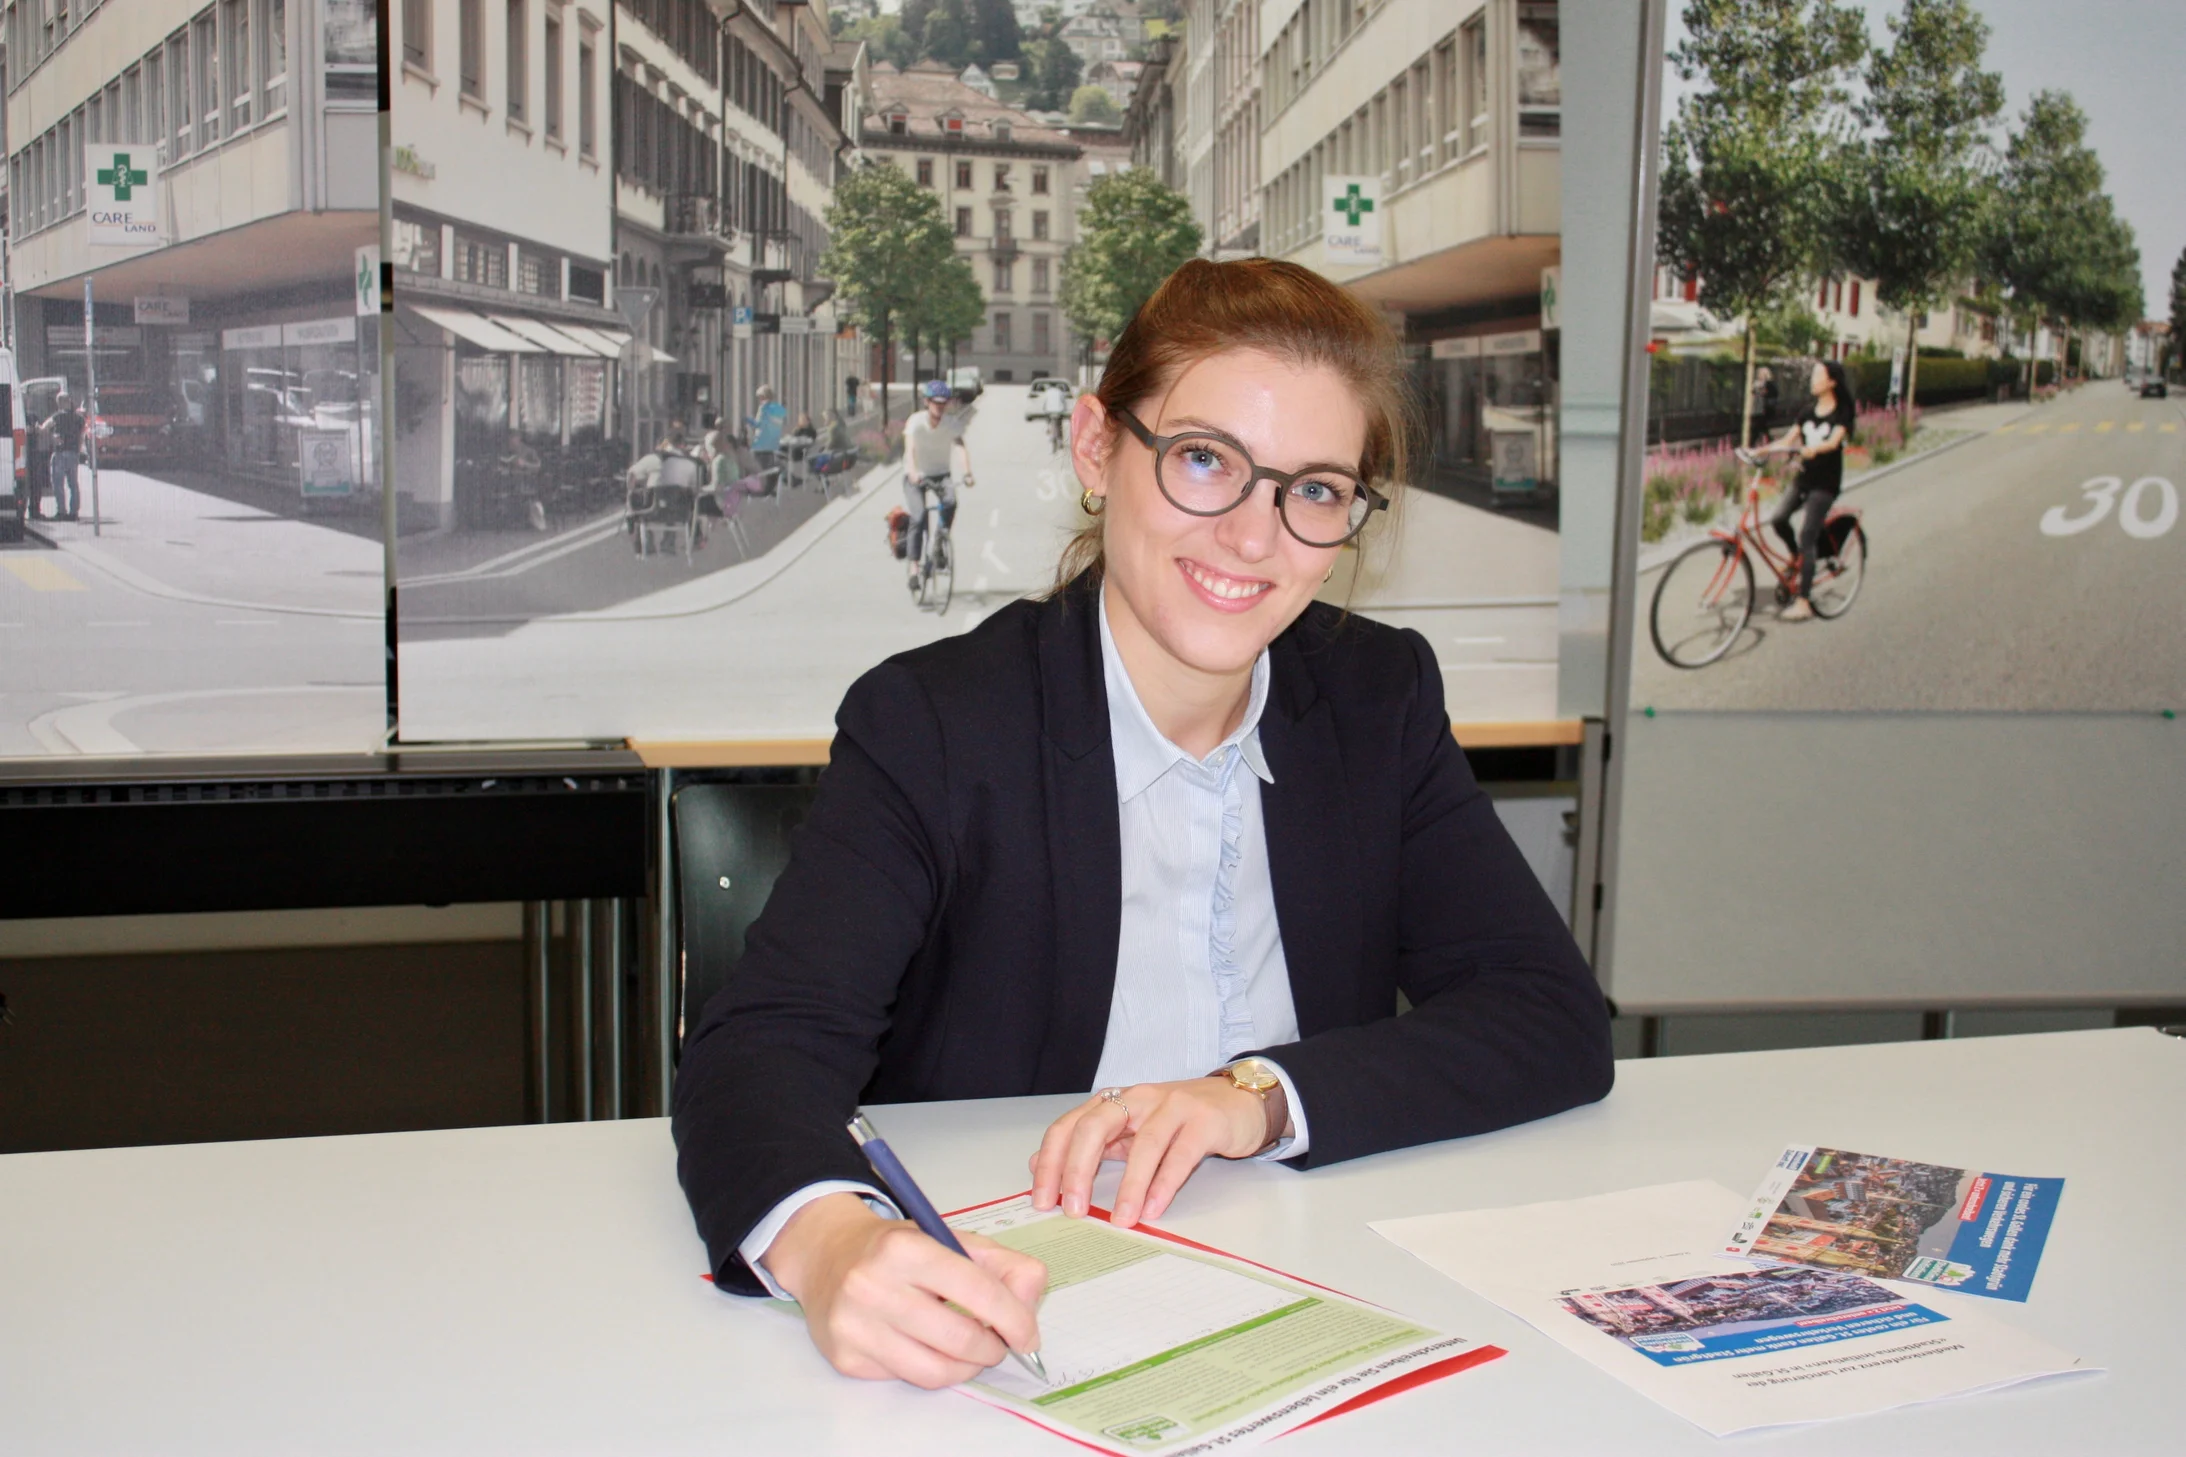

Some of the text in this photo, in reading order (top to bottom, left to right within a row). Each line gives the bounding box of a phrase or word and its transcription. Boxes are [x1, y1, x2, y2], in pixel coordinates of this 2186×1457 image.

[92, 212, 134, 225] CARE
[124, 225, 157, 233] LAND
[1327, 235, 1362, 246] CARE
[137, 301, 170, 312] CARE
[2039, 475, 2180, 539] 30
[2023, 1183, 2039, 1192] Für
[2019, 1191, 2036, 1199] ein
[2014, 1199, 2031, 1214] cooles
[1979, 1181, 2016, 1248] und sicheren Verkehrswegen
[2006, 1221, 2025, 1237] Gallen
[2001, 1236, 2019, 1250] dank
[1995, 1250, 2012, 1264] mehr
[1985, 1263, 2009, 1290] Stadtgrün
[1796, 1310, 1867, 1327] unterschreiben!
[1890, 1320, 1910, 1328] ein
[1754, 1312, 1918, 1344] und sicheren Verkehrswegen
[1852, 1324, 1890, 1335] cooles
[1798, 1334, 1836, 1345] Gallen
[1835, 1331, 1853, 1339] St.
[1734, 1345, 1767, 1355] mehr
[1766, 1340, 1797, 1350] dank
[1376, 1337, 1467, 1371] Unterschreiben
[1673, 1350, 1735, 1363] Stadtgrün
[1805, 1337, 1947, 1369] «Stadtklima-Initiativen»
[1860, 1343, 1965, 1370] Medienkonferenz
[1358, 1365, 1380, 1377] Sie
[1838, 1366, 1857, 1374] zur
[1339, 1374, 1361, 1385] für
[1767, 1369, 1838, 1386] Lancierung
[1317, 1384, 1339, 1396] ein
[1228, 1393, 1322, 1438] lebenswertes
[1210, 1436, 1232, 1446] St.
